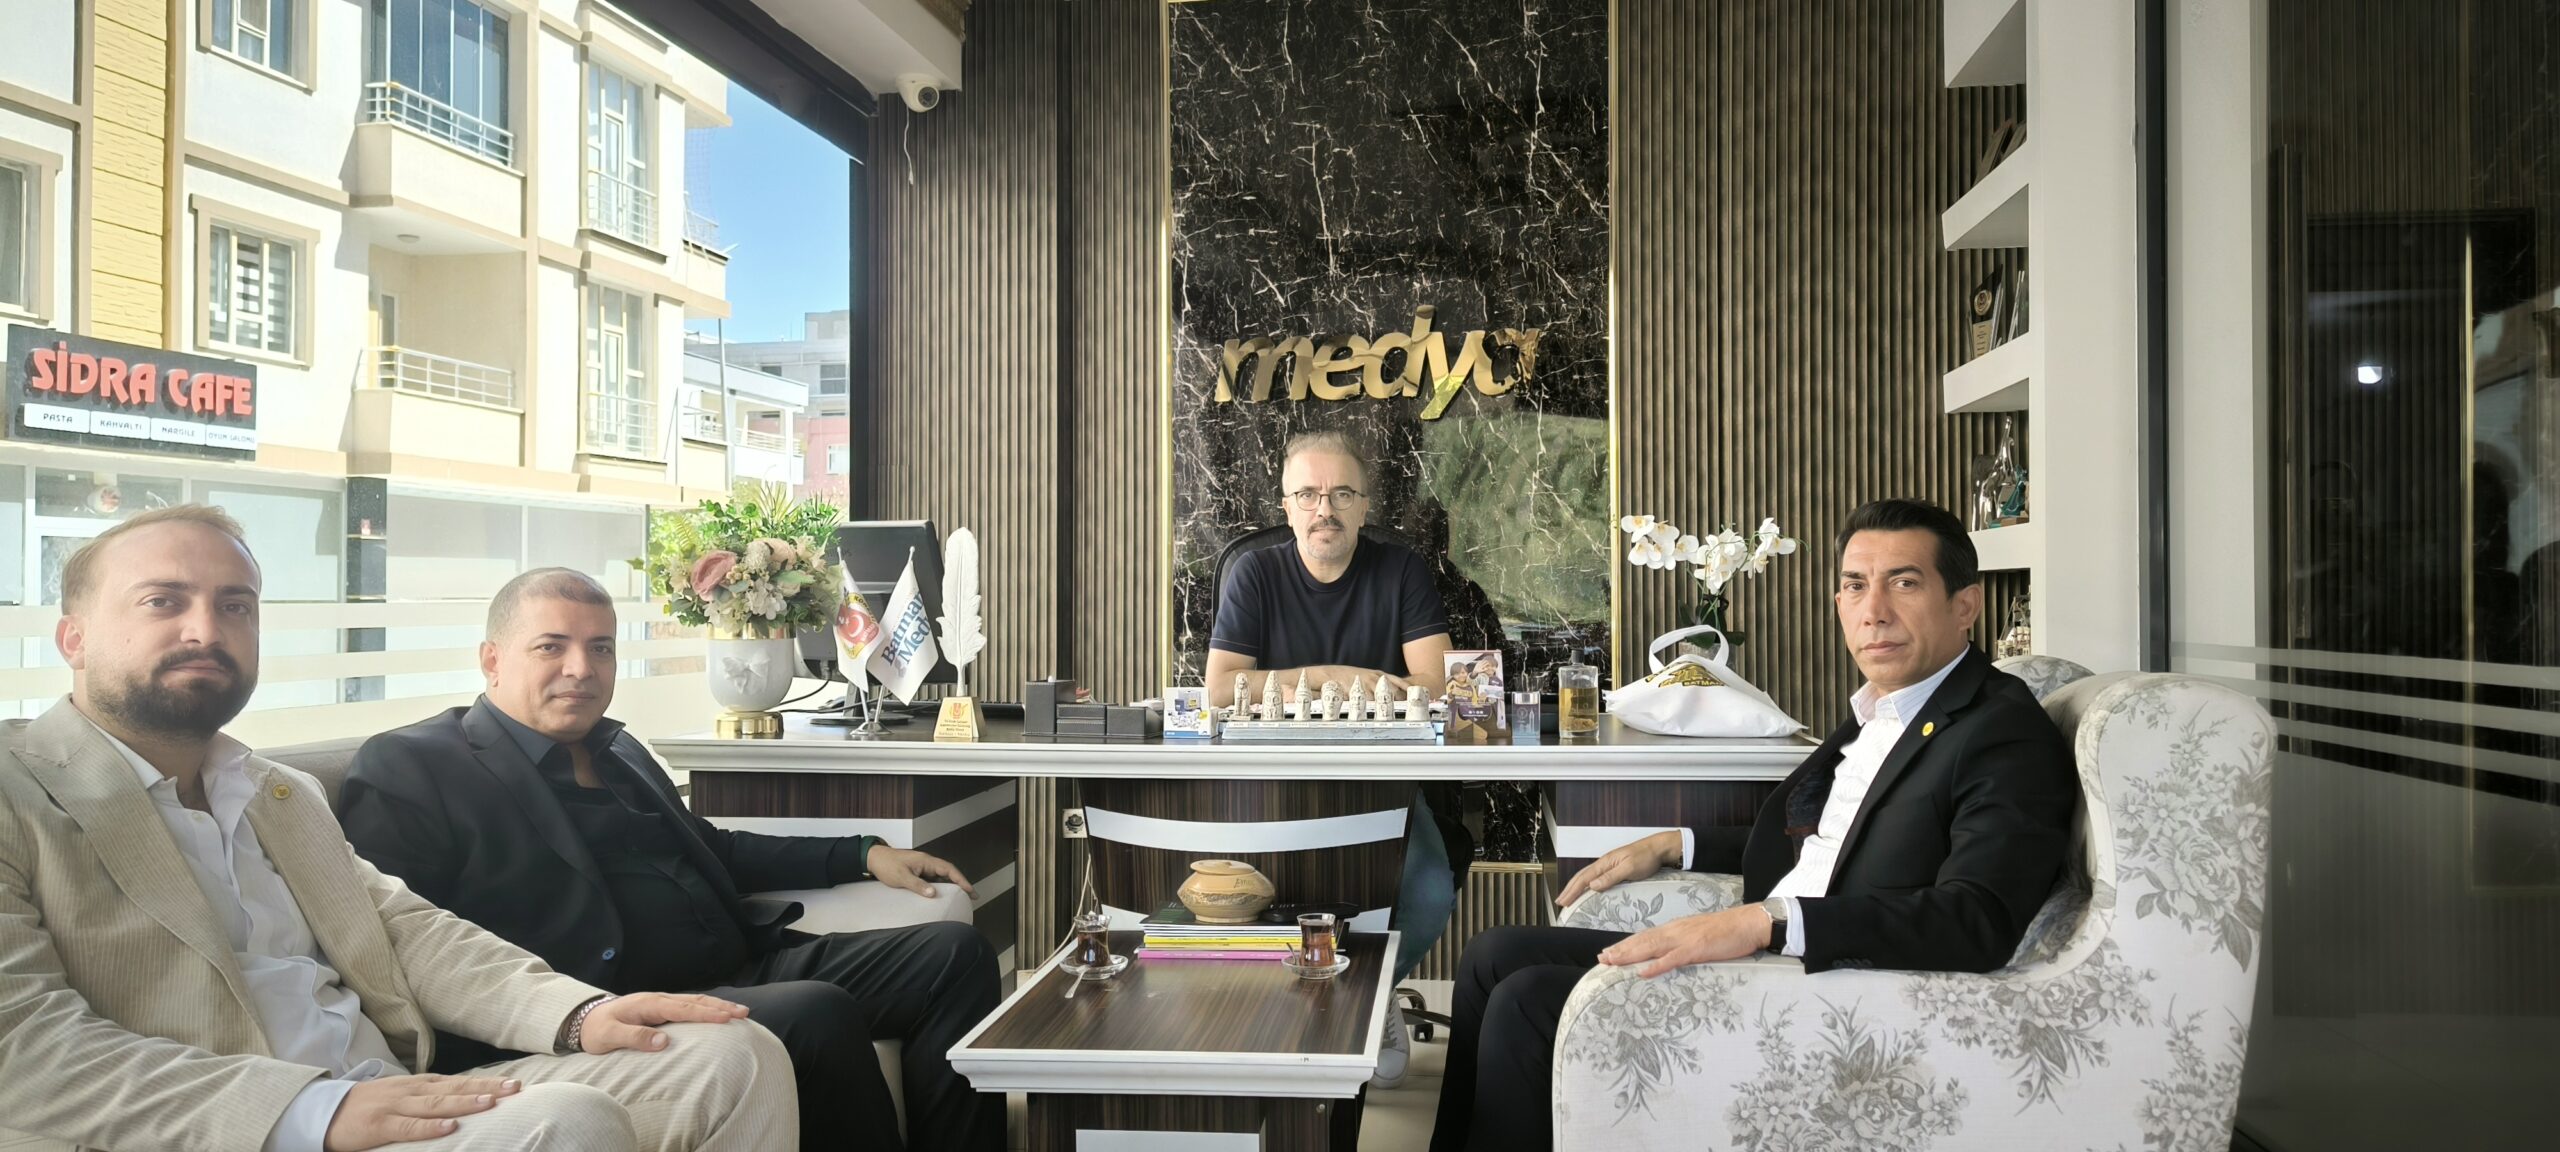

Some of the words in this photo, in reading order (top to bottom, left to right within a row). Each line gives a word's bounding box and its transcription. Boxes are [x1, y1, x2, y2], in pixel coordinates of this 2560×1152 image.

[31, 340, 157, 405] SİDRA
[168, 368, 253, 416] CAFE
[1214, 305, 1542, 420] medya
[43, 413, 73, 424] PASTA
[100, 419, 142, 431] KAHVALTI
[897, 615, 930, 664] Med
